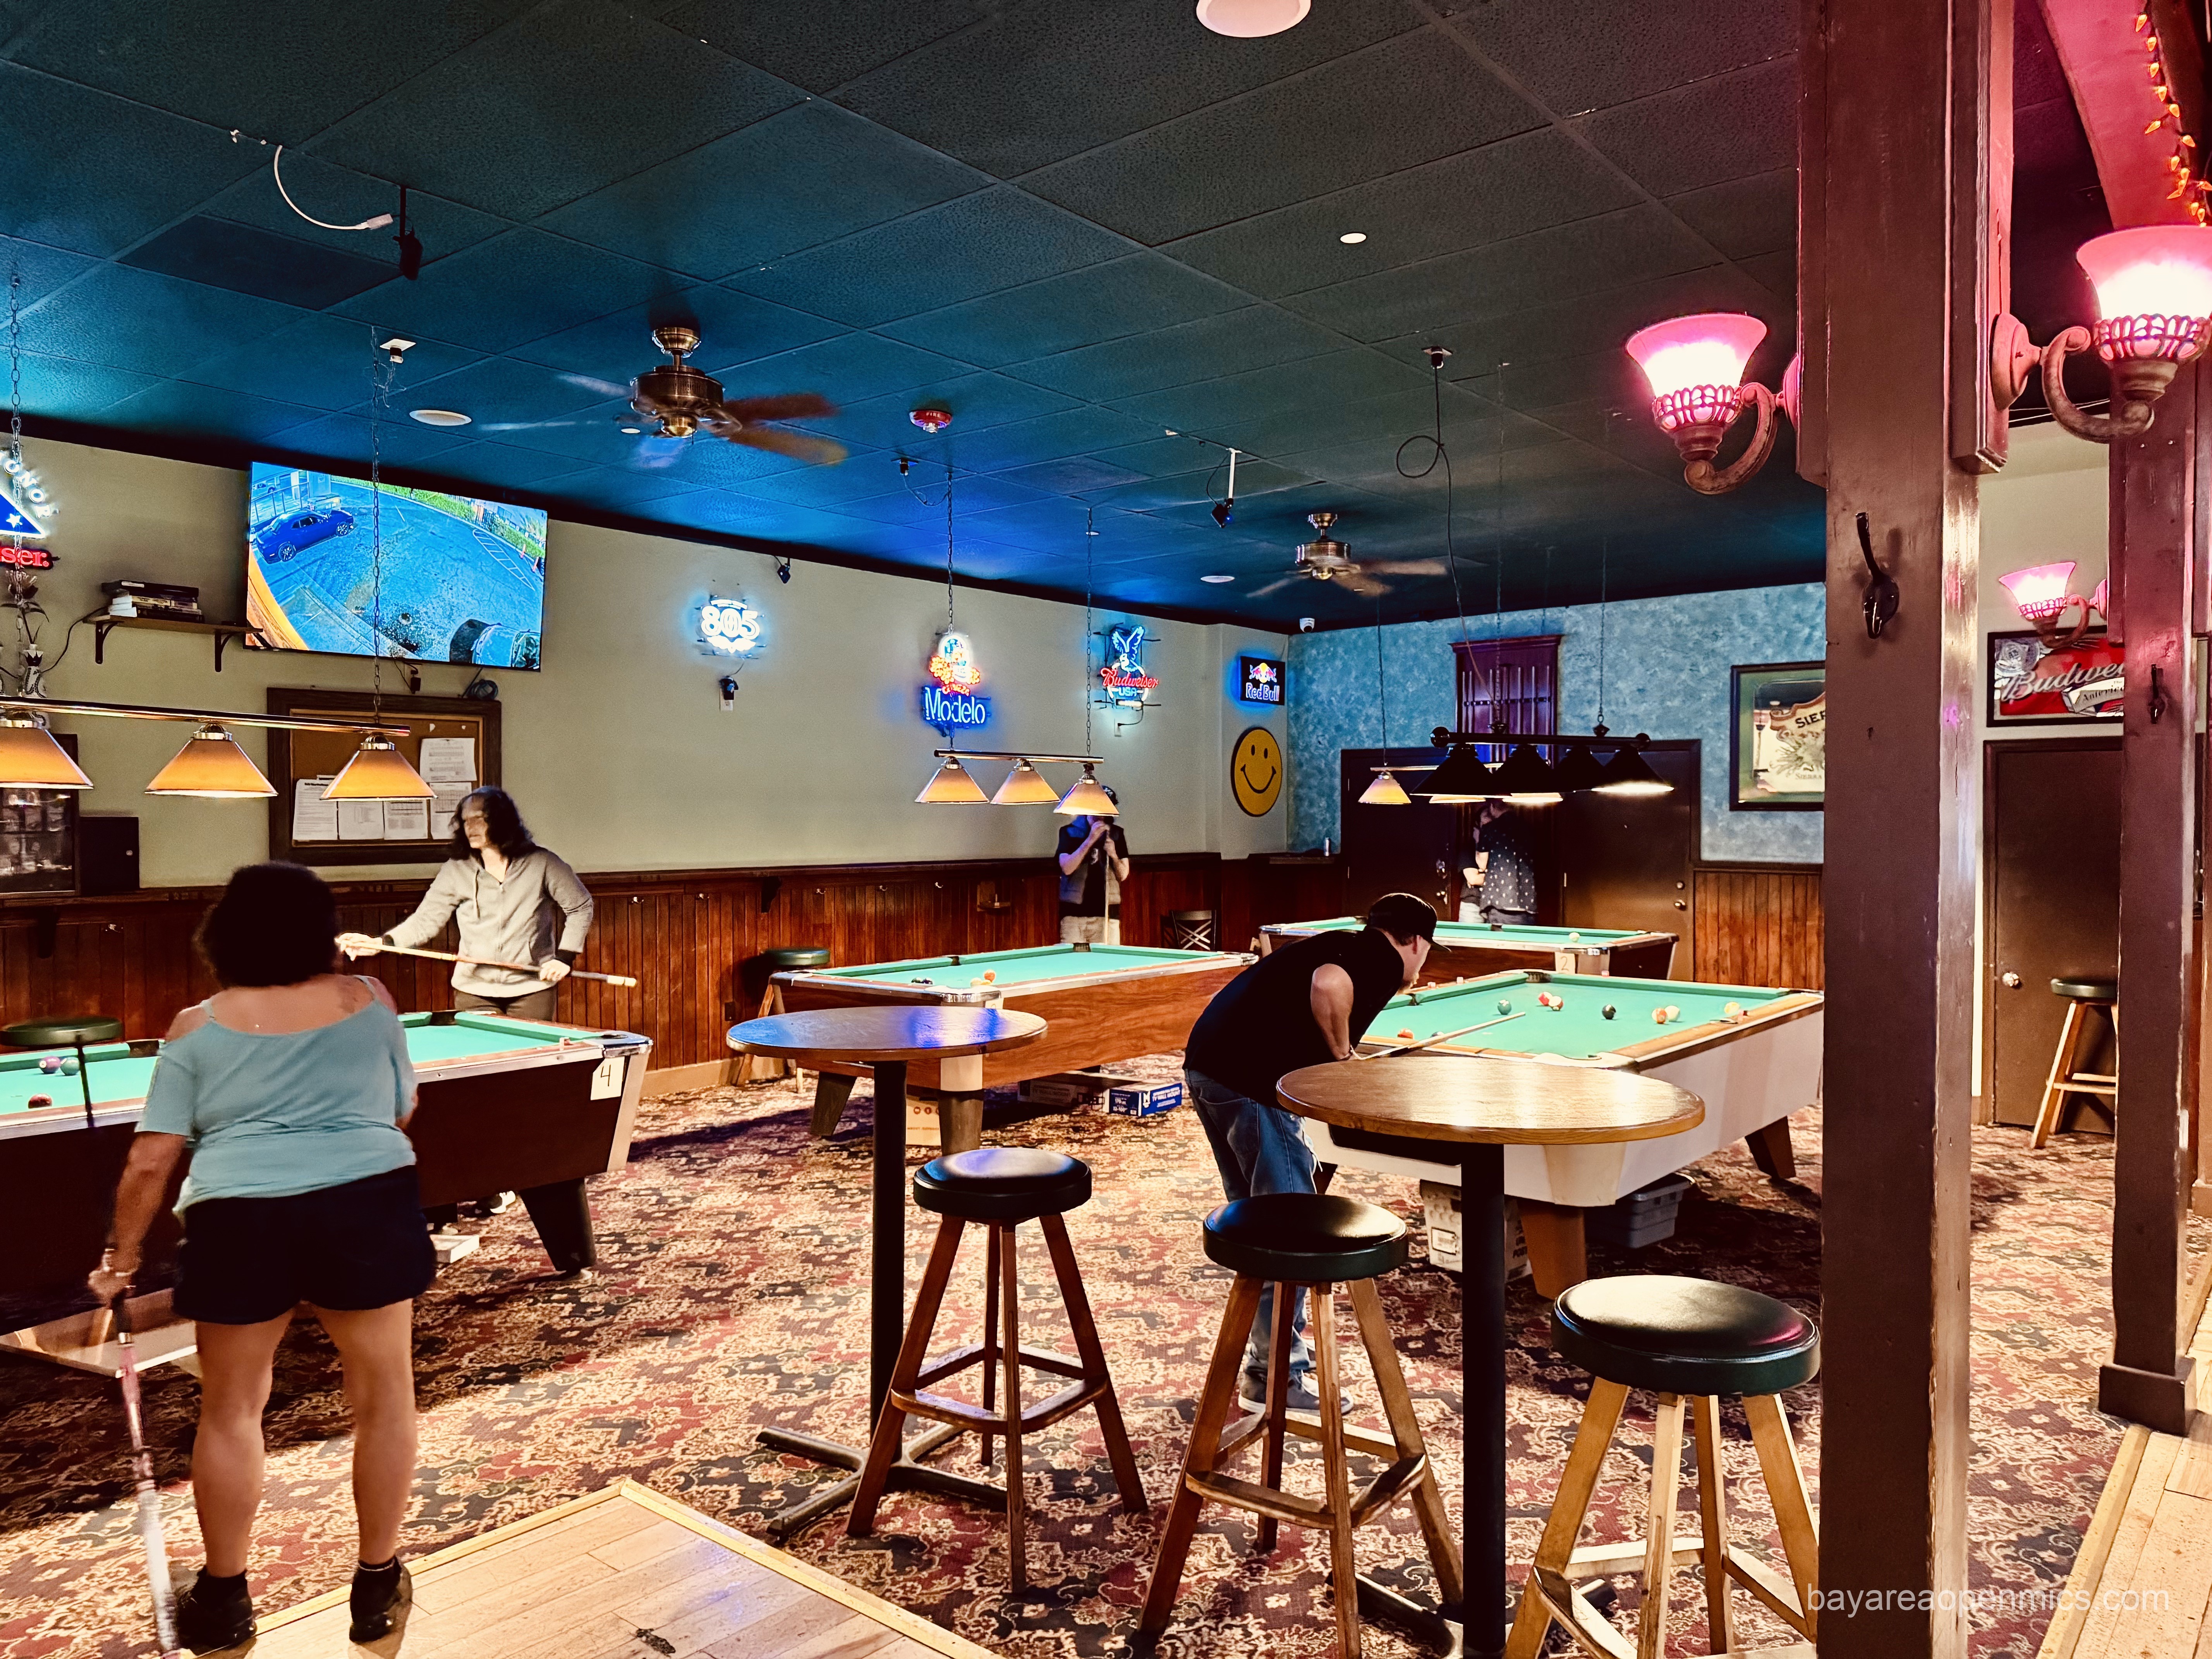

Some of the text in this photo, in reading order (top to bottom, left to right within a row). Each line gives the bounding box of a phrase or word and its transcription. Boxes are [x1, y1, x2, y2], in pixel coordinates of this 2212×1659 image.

[701, 605, 760, 639] 805
[1101, 668, 1159, 688] Budweiser
[1118, 687, 1137, 697] USA
[1246, 682, 1280, 701] Red Bull
[924, 687, 986, 724] Modelo
[1561, 956, 1570, 972] 2
[601, 1064, 611, 1087] 4
